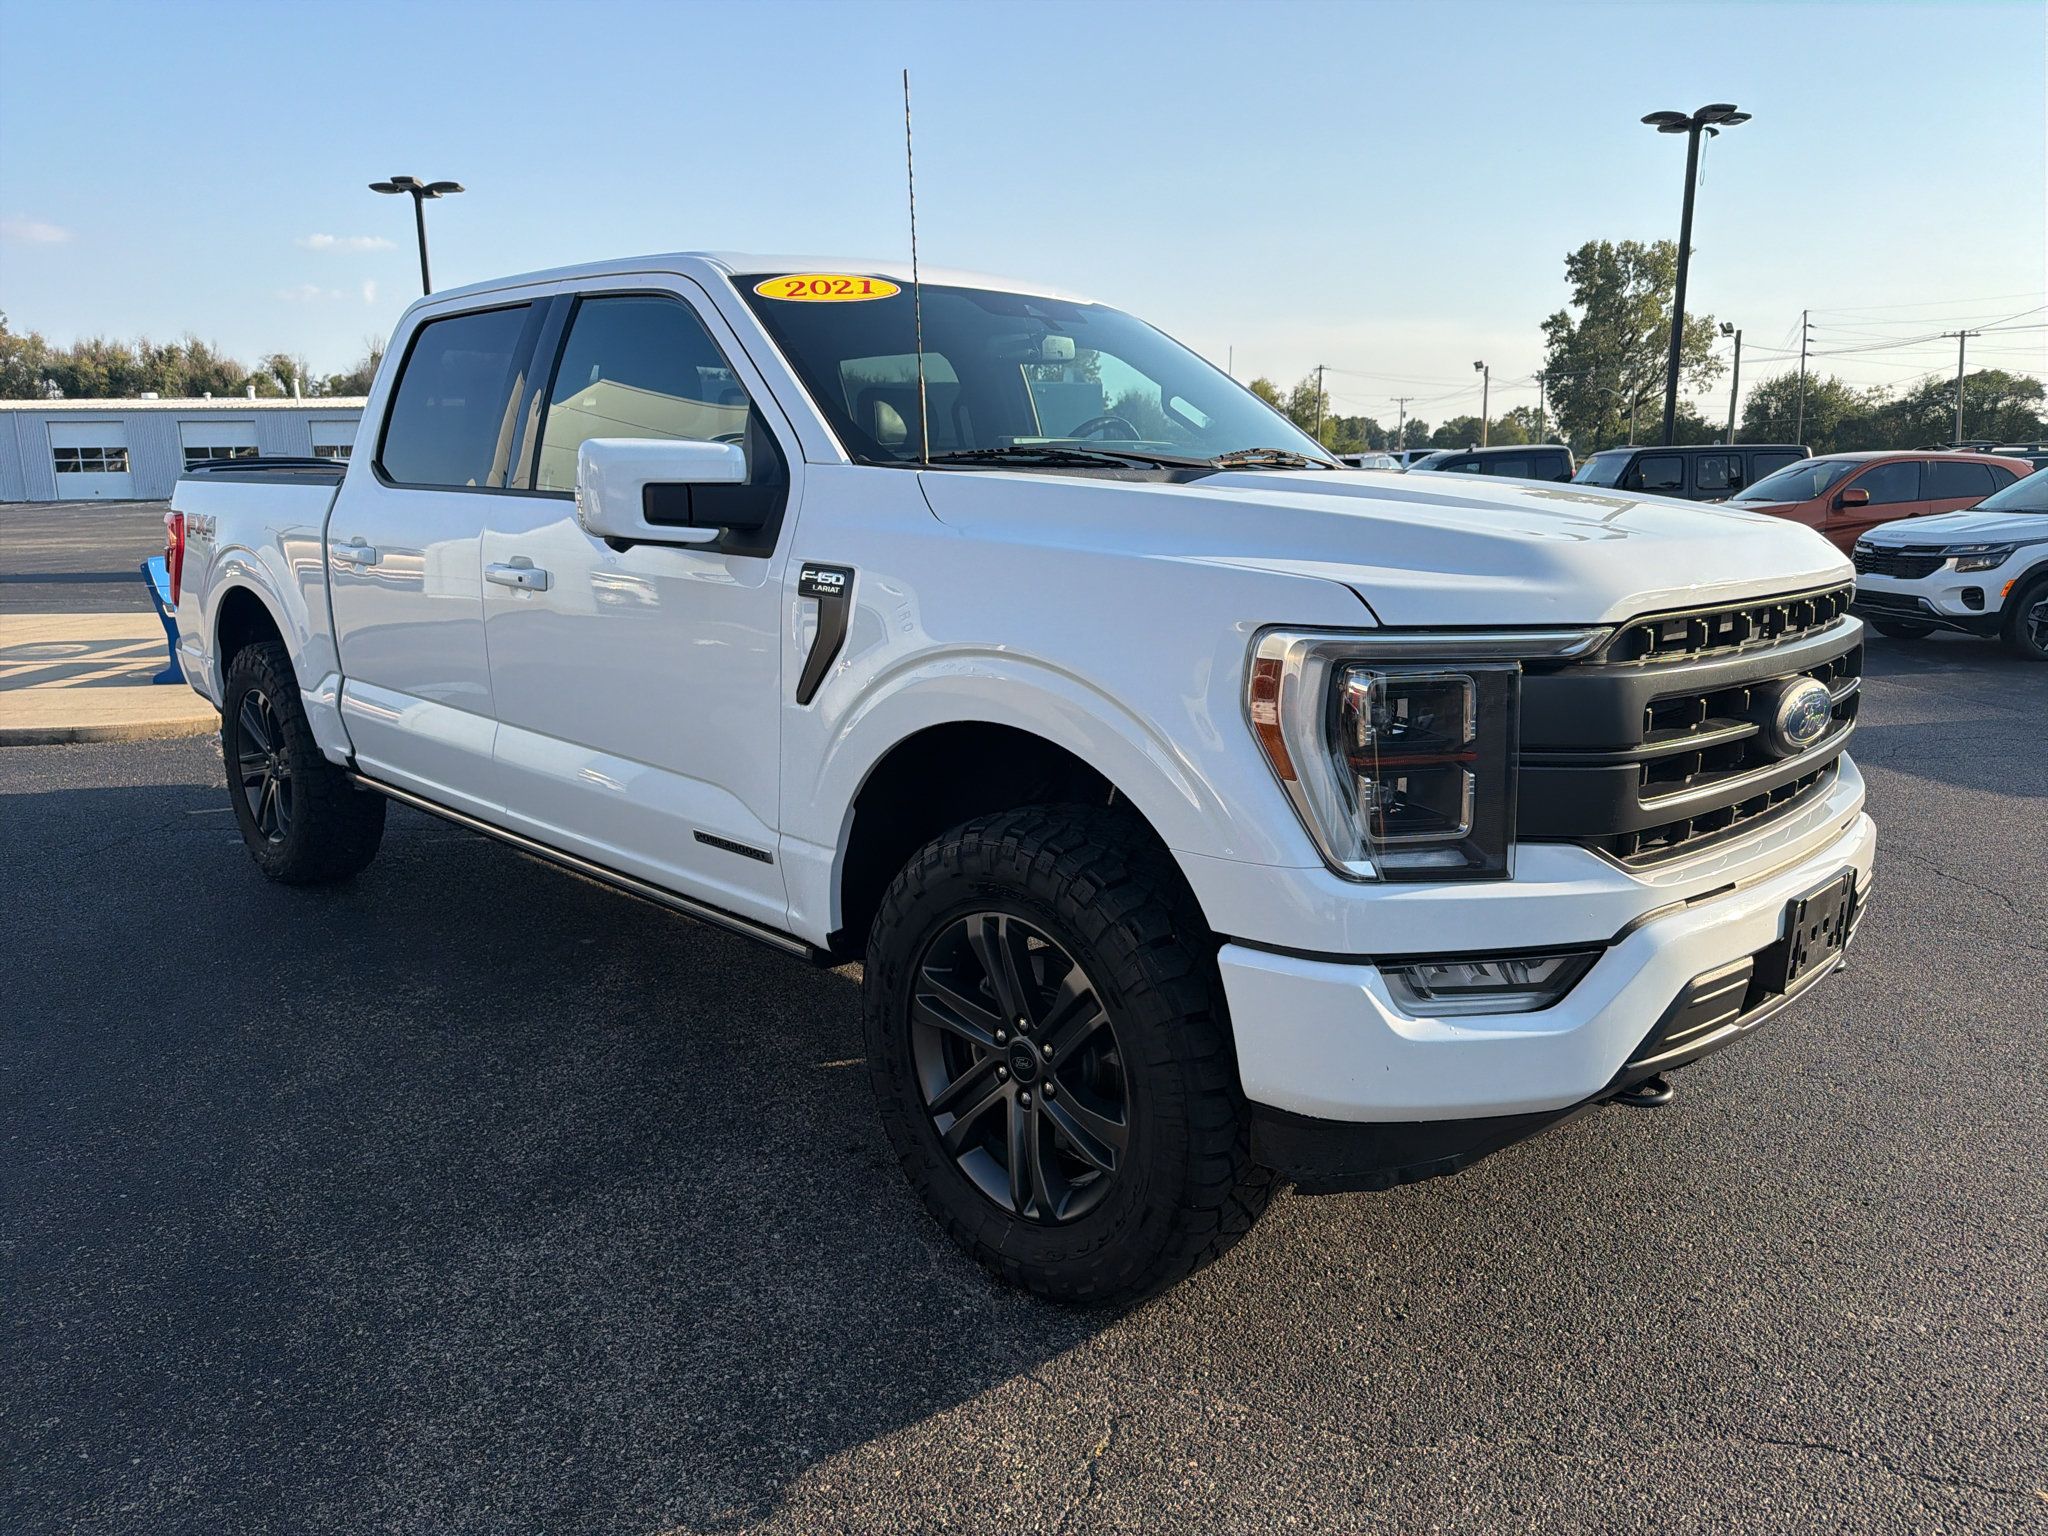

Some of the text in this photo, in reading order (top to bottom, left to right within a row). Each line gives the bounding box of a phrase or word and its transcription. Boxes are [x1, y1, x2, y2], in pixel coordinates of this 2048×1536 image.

[784, 279, 876, 297] 2021
[187, 513, 217, 537] FX4
[801, 570, 846, 586] F-150
[812, 584, 841, 594] LARIAT
